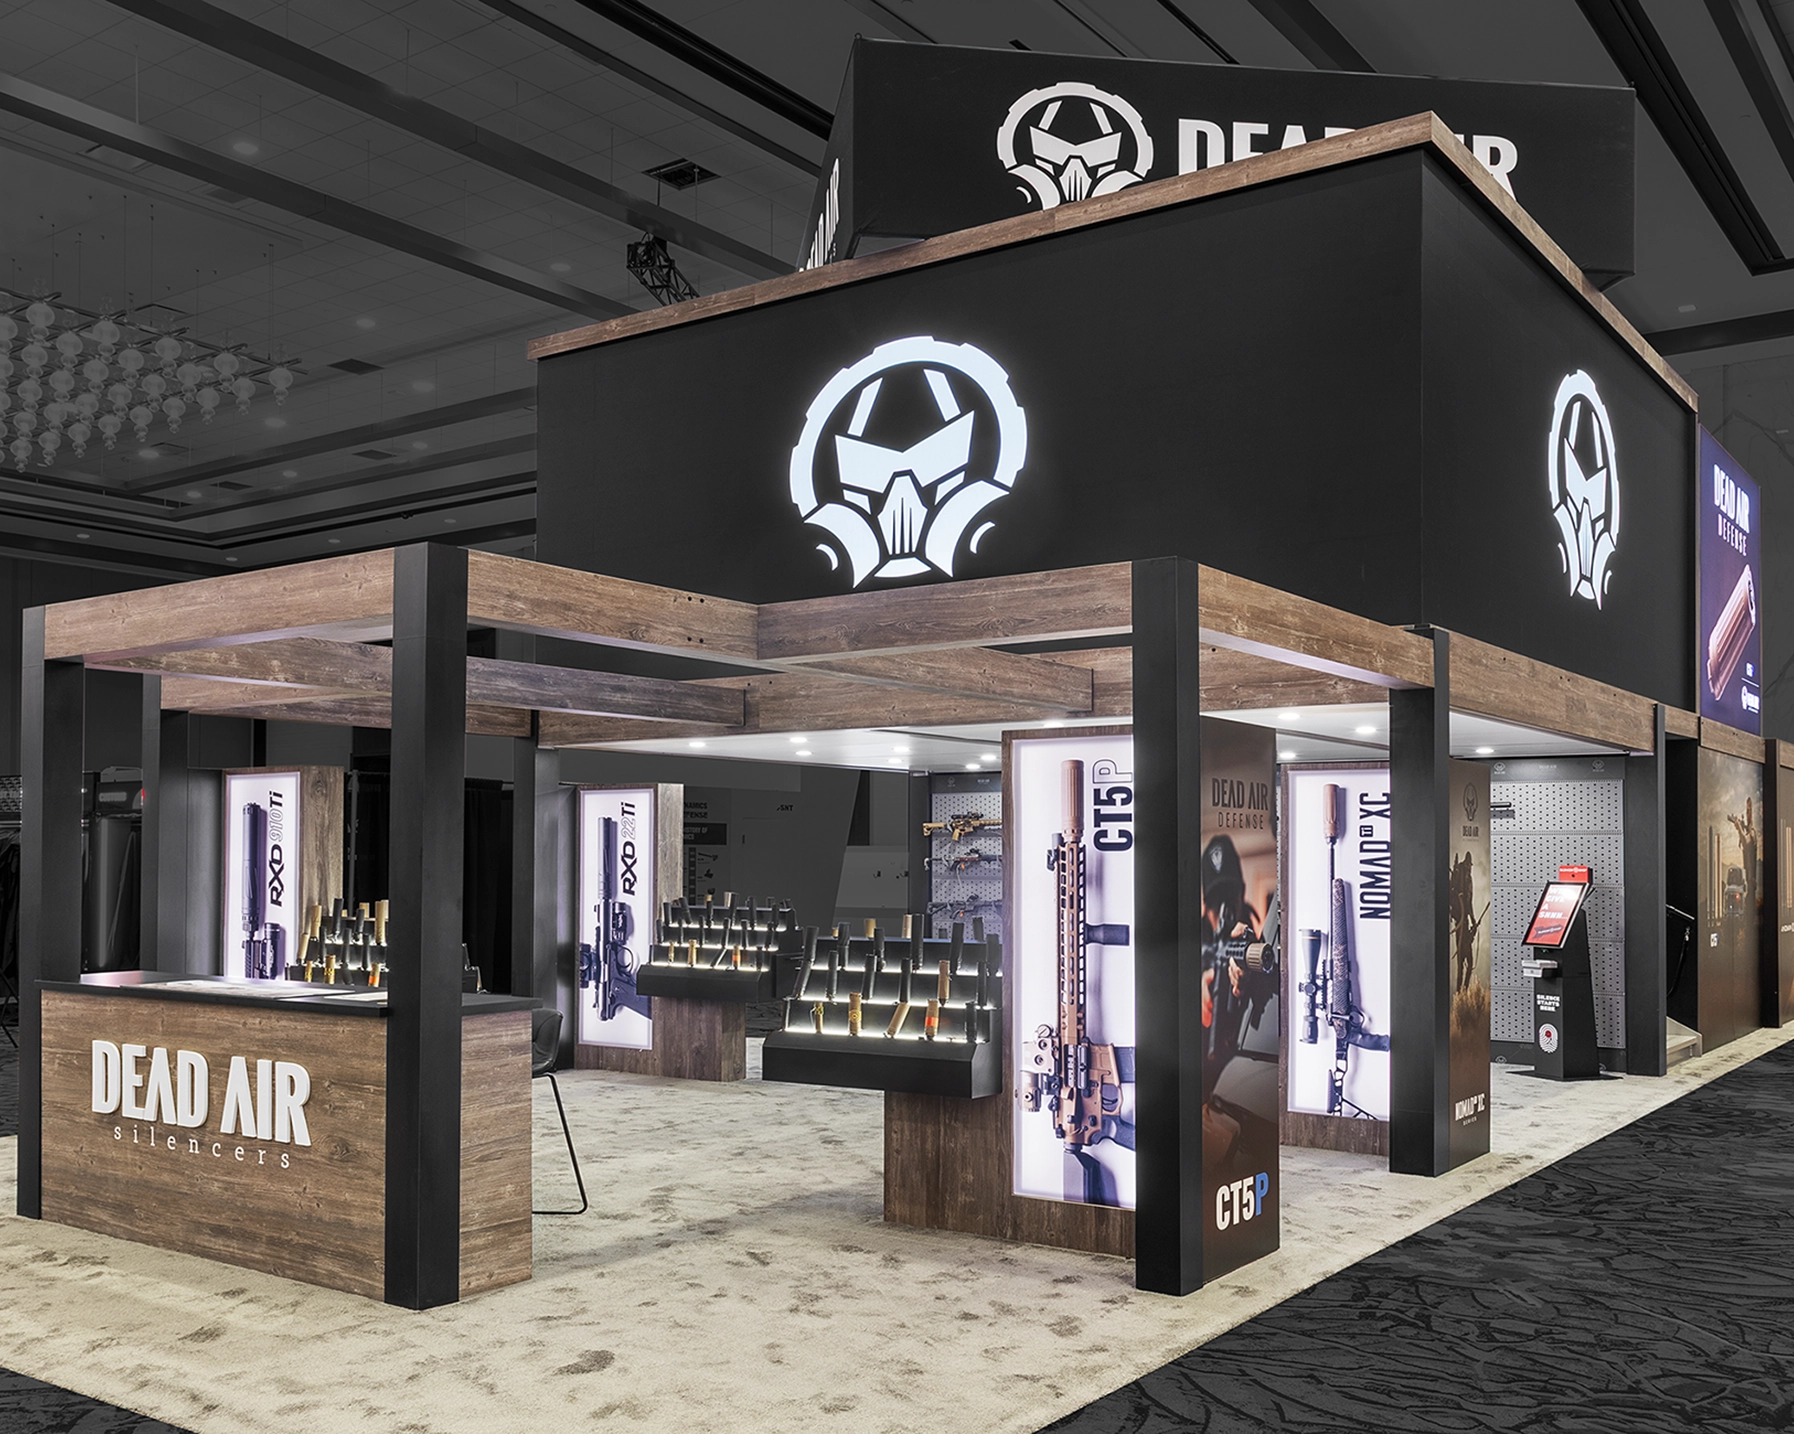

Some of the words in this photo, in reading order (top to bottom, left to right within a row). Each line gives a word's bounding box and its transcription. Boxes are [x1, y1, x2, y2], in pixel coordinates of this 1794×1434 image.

[1713, 463, 1736, 520] DEAD
[1735, 487, 1751, 534] AIR
[1717, 513, 1748, 556] DEFENSE
[1093, 758, 1134, 852] CT5P
[1211, 777, 1246, 809] DEAD
[1247, 783, 1269, 811] AIR
[1359, 792, 1391, 820] XC
[1217, 811, 1264, 830] DEFENSE
[1359, 840, 1391, 919] NOMAD
[92, 1039, 209, 1128] DEAD
[219, 1056, 312, 1146] AIR
[113, 1124, 290, 1169] silencers
[1215, 1171, 1269, 1231] CT5P
